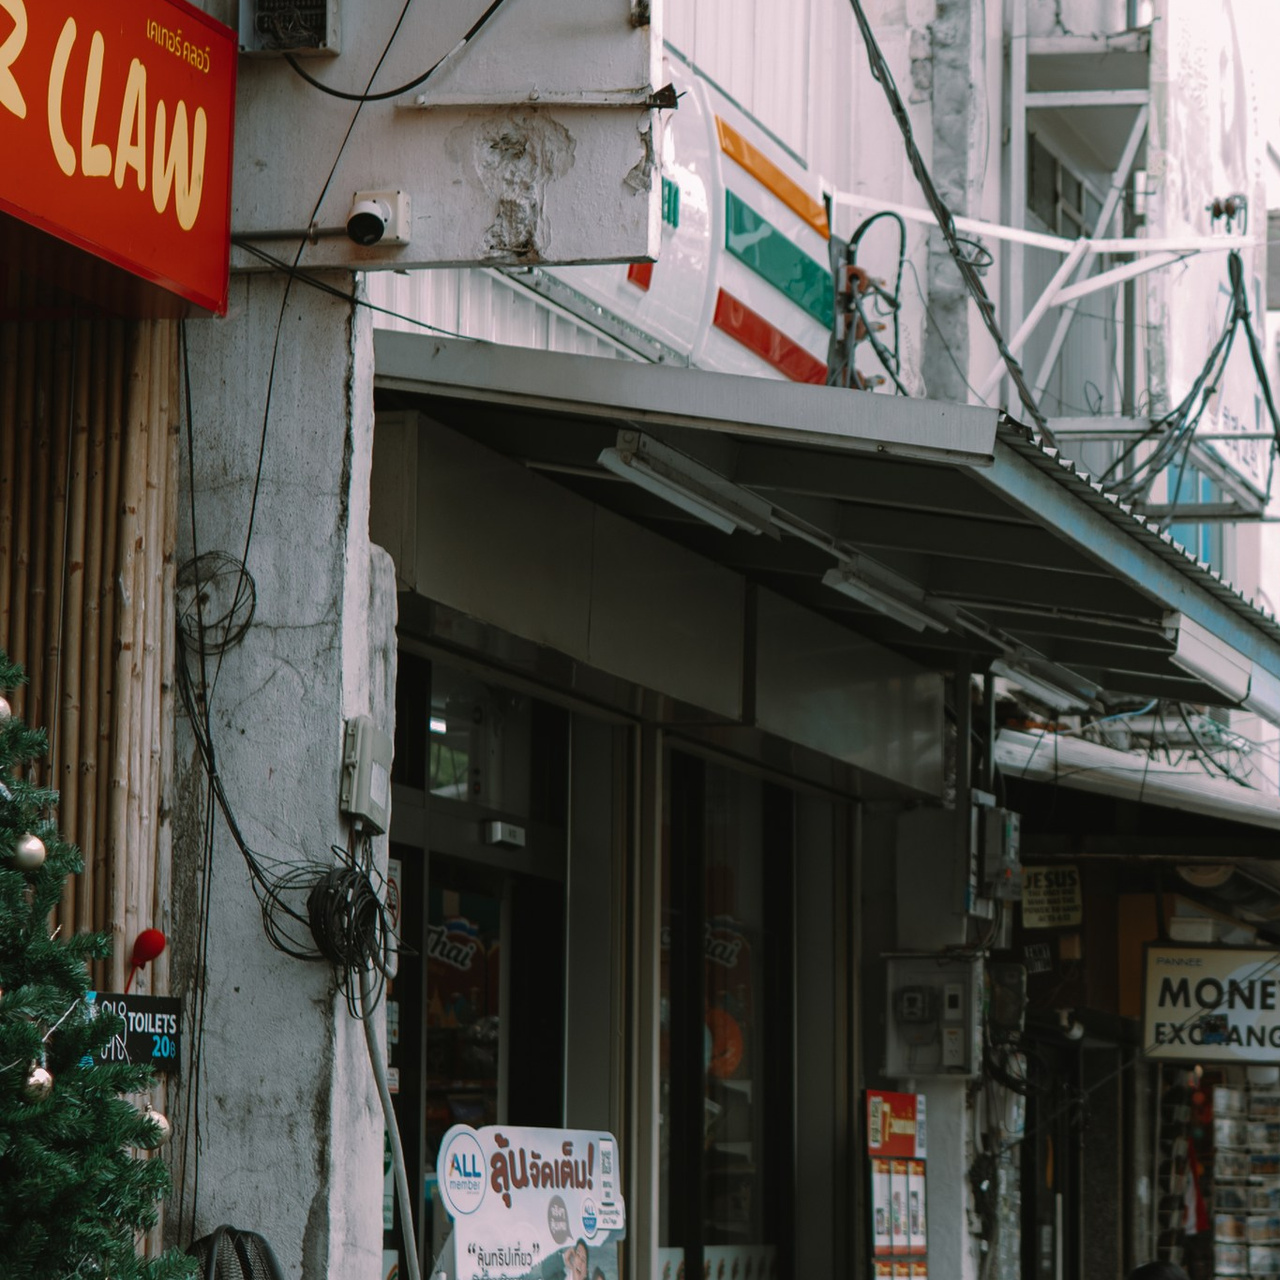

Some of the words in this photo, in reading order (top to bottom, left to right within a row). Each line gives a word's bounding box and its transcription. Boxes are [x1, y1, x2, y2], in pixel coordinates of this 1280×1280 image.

[47, 16, 207, 232] CLAW
[1023, 870, 1078, 889] JESUS
[1156, 957, 1203, 967] PANNEE
[128, 1011, 177, 1035] TOILETS
[450, 1152, 482, 1179] ALL
[450, 1179, 481, 1190] member
